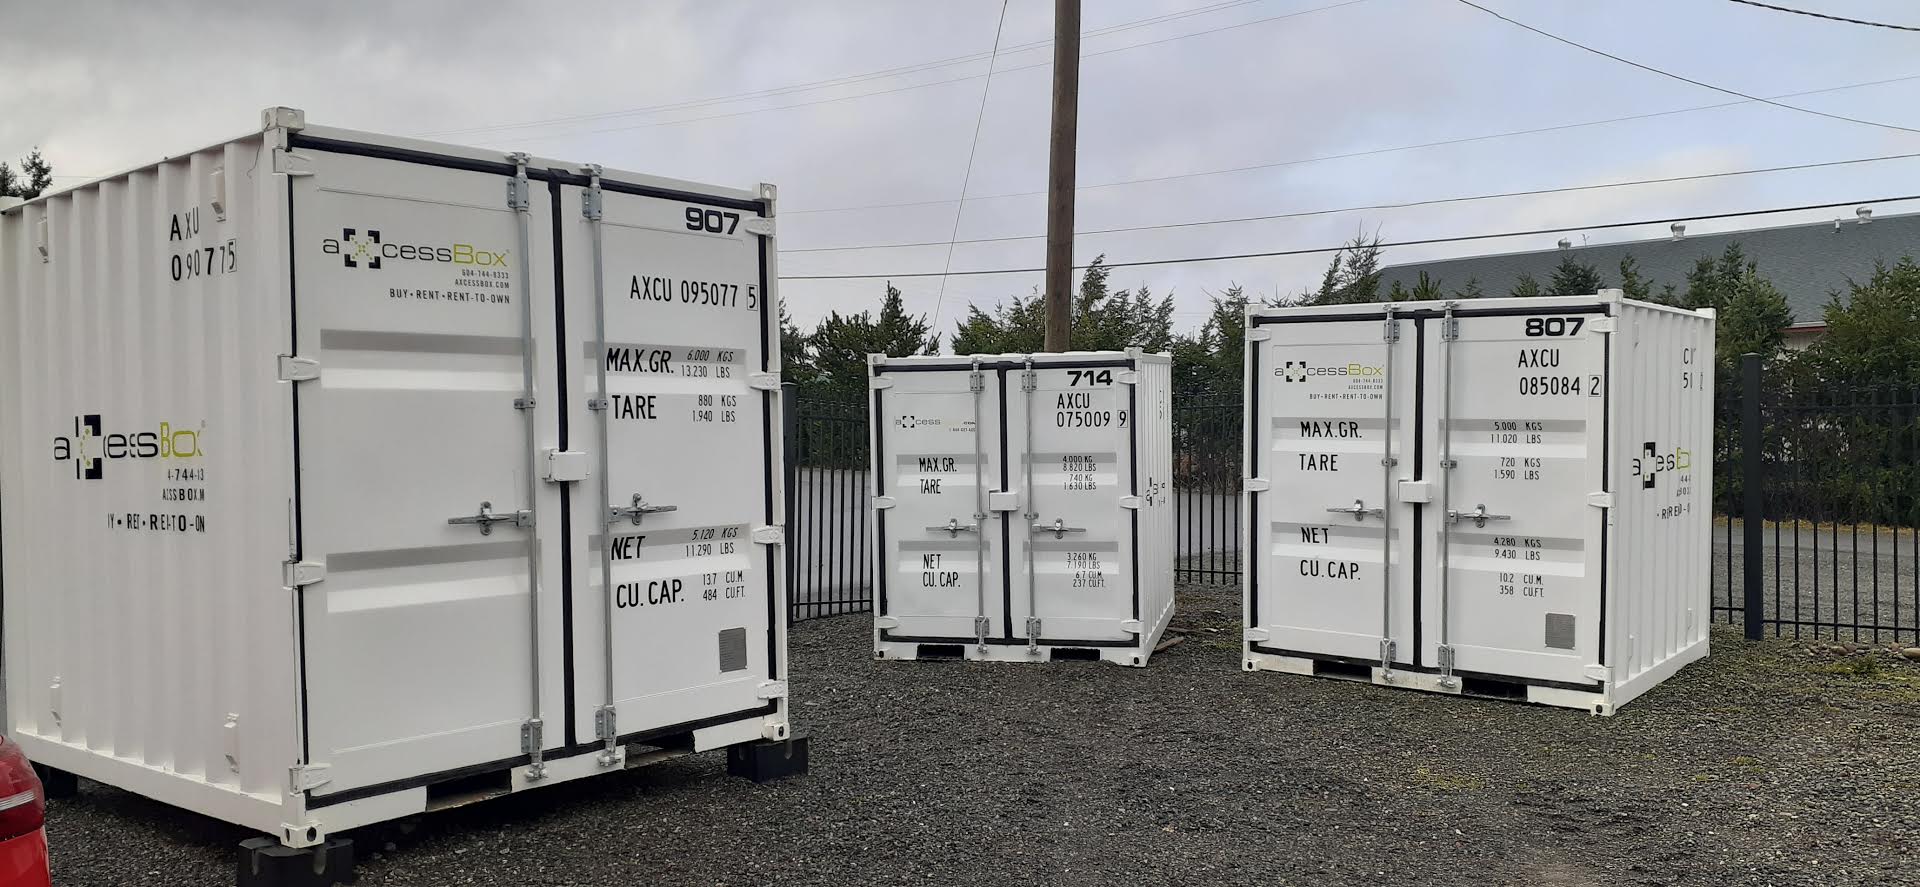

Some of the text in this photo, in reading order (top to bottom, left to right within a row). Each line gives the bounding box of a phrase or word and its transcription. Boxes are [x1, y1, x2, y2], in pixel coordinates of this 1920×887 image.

[686, 206, 740, 235] 907
[630, 275, 757, 310] AXCU 095077 5
[1526, 318, 1584, 336] 807
[606, 348, 674, 374] MAX.GR.
[687, 349, 734, 362] 6.000 KGS
[1518, 348, 1560, 368] AXCU
[681, 364, 730, 378] 13.230 LBS
[1067, 370, 1113, 386] 714
[1520, 376, 1600, 396] 085084 2
[612, 395, 657, 420] TARE
[698, 395, 736, 407] 880 KGS
[1057, 393, 1090, 409] AXCU
[692, 410, 736, 422] 1.940 LBS
[1057, 410, 1127, 428] 075009 9
[1300, 421, 1362, 438] MAX.GR.
[1526, 422, 1542, 430] KGS
[1492, 434, 1542, 444] 11.020 LBS
[1084, 463, 1096, 472] LBS
[1299, 454, 1338, 472] TARE
[1500, 457, 1540, 468] 720 KGS
[1070, 474, 1092, 482] 740 KG
[1524, 470, 1540, 480] LBS
[920, 479, 942, 494] TARE
[1084, 482, 1096, 490] LBS
[692, 528, 738, 541] 5.120 KGS
[1301, 526, 1328, 544] NET
[611, 536, 646, 560] NET
[1524, 538, 1542, 548] KGS
[686, 543, 734, 557] 11.290 LBS
[1088, 552, 1096, 560] KG
[1526, 551, 1540, 560] LBS
[924, 554, 941, 569] NET
[1088, 561, 1100, 570] LBS
[1072, 579, 1086, 588] 237
[1500, 585, 1514, 595] 358
[702, 588, 717, 601] 484
